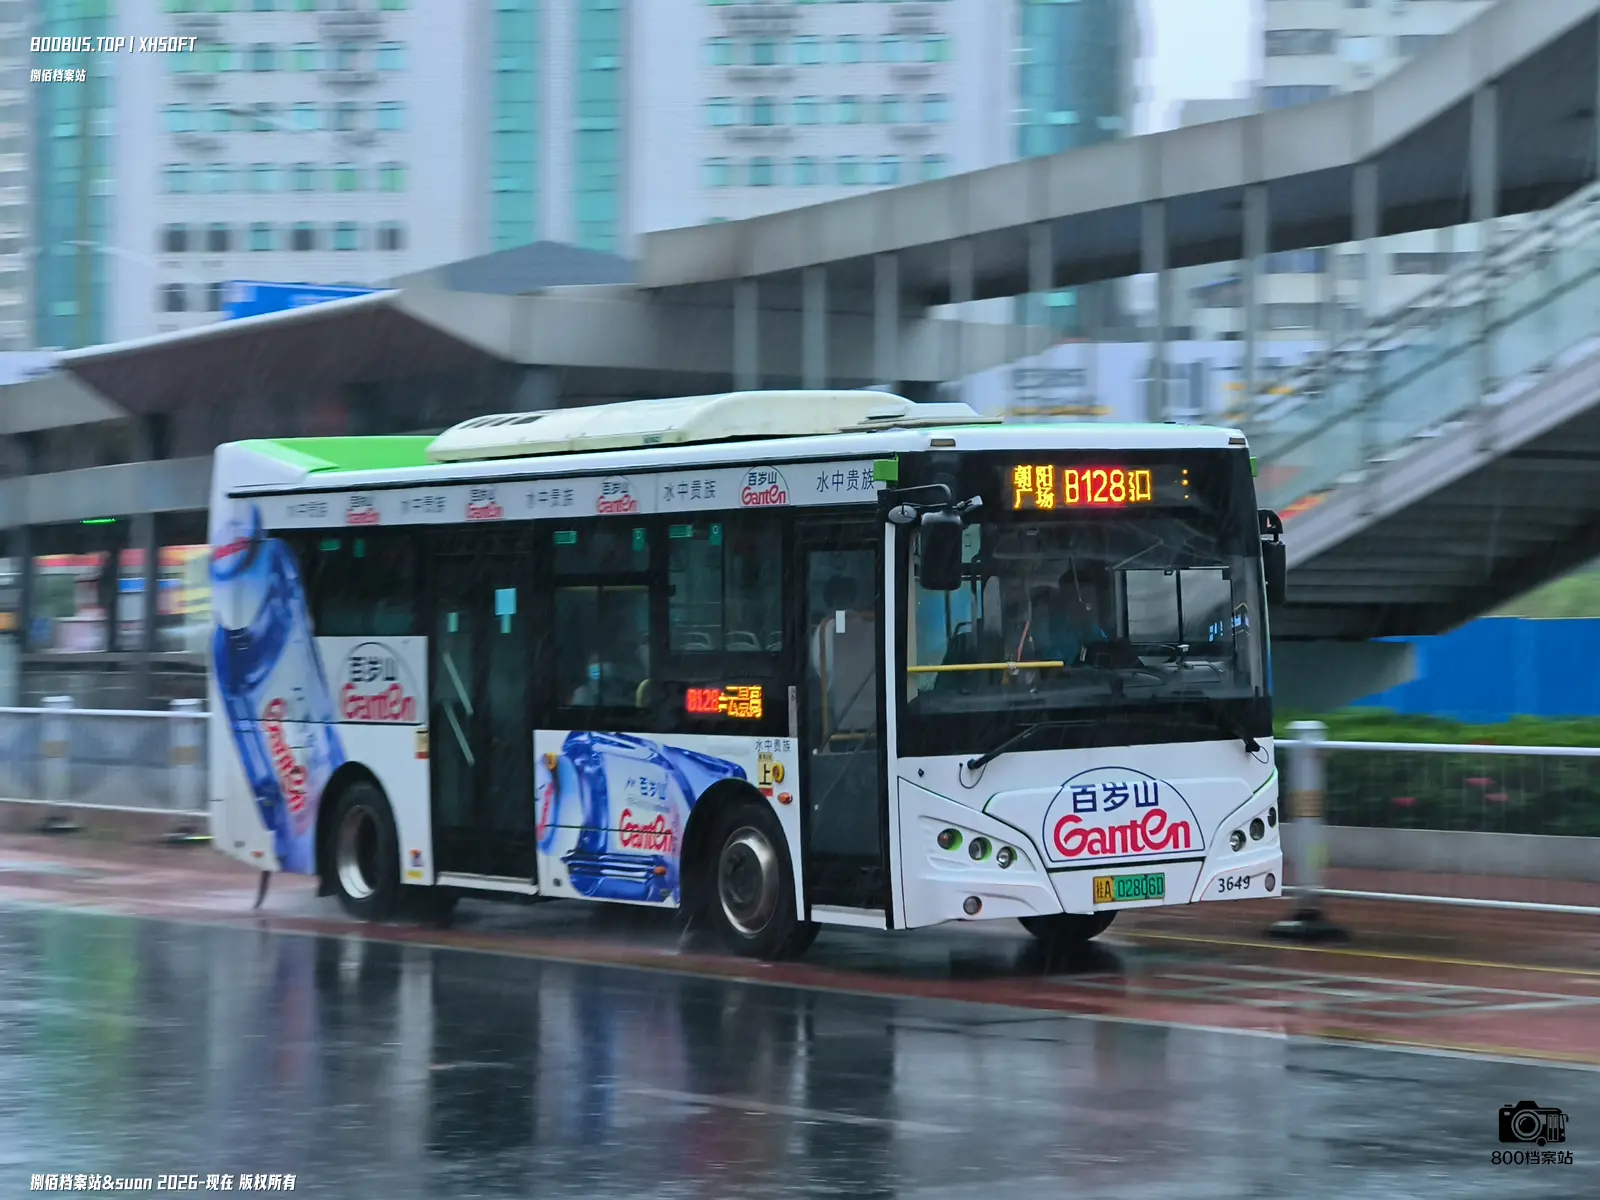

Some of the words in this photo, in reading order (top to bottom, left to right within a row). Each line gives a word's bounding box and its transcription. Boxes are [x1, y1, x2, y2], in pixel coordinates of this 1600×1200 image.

[747, 471, 778, 486] 百岁山
[815, 468, 875, 493] 水中贵族
[1064, 469, 1127, 503] B128
[663, 480, 717, 501] 水中贵族
[741, 484, 787, 505] Ganten
[1069, 780, 1160, 814] 百岁山
[1053, 808, 1191, 857] Ganten
[1217, 875, 1251, 893] 3649
